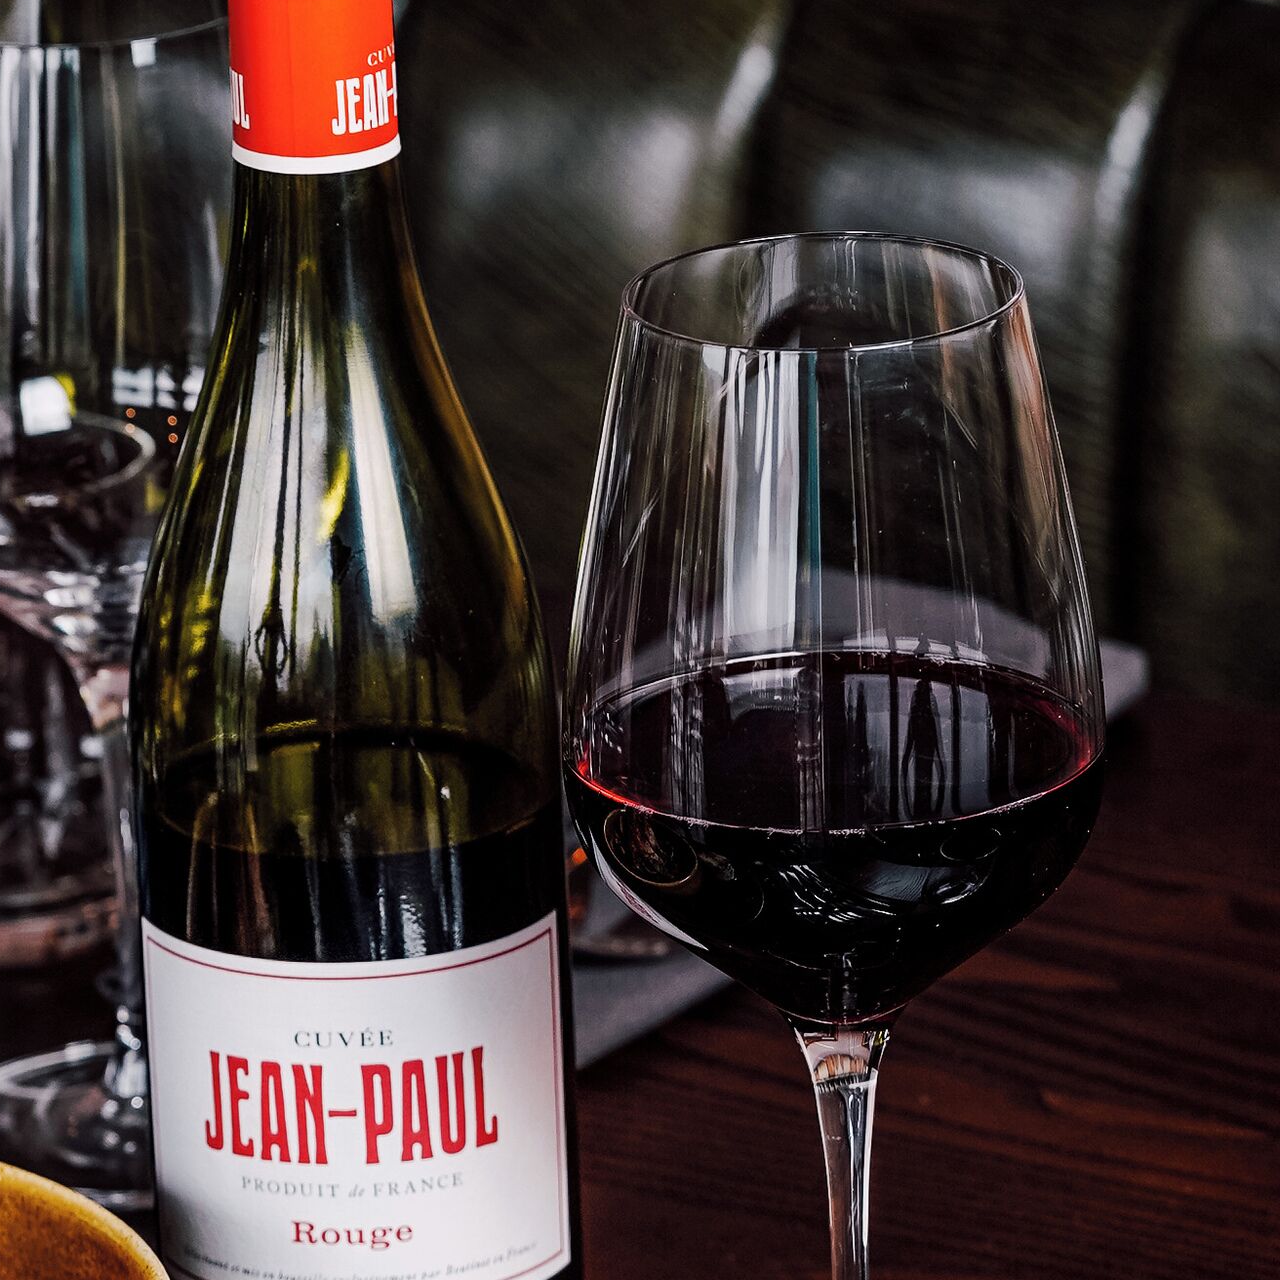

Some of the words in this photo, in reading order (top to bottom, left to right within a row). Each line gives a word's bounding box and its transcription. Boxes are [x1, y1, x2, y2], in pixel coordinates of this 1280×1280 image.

[367, 38, 395, 67] CUV
[229, 66, 251, 130] UL
[294, 1027, 395, 1048] CUVÉE
[205, 1045, 499, 1165] JEAN-PAUL
[241, 1175, 339, 1199] PRODUIT
[348, 1183, 366, 1199] de
[372, 1171, 464, 1198] FRANCE
[290, 1220, 415, 1250] Rouge
